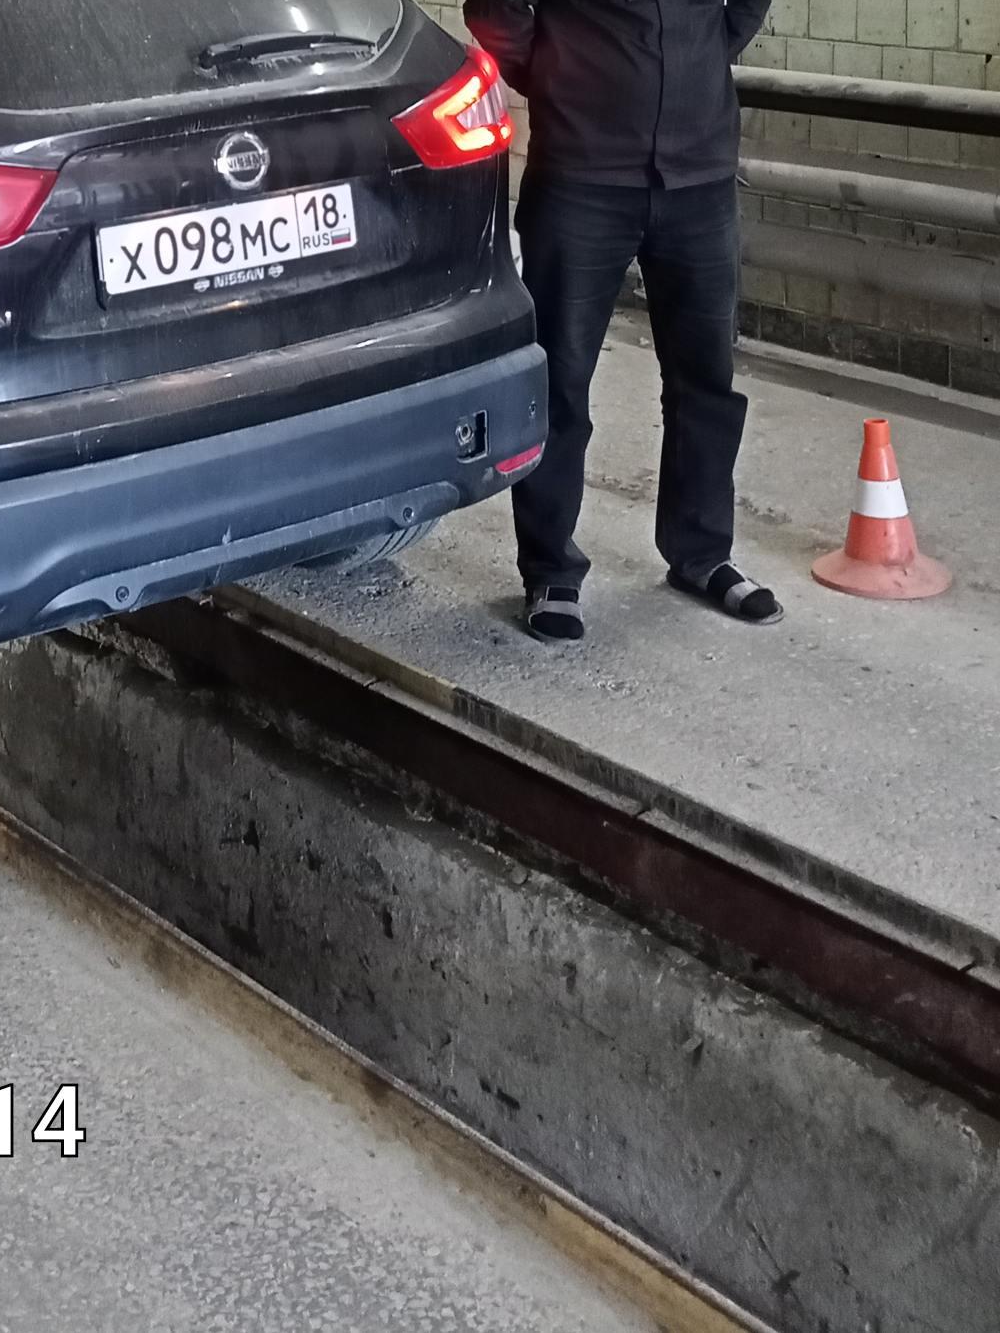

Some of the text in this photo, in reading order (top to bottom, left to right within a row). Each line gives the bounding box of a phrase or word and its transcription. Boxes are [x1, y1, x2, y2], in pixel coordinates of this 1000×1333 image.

[303, 193, 340, 232] 18
[302, 235, 330, 250] RUS
[213, 266, 265, 289] NISSAN
